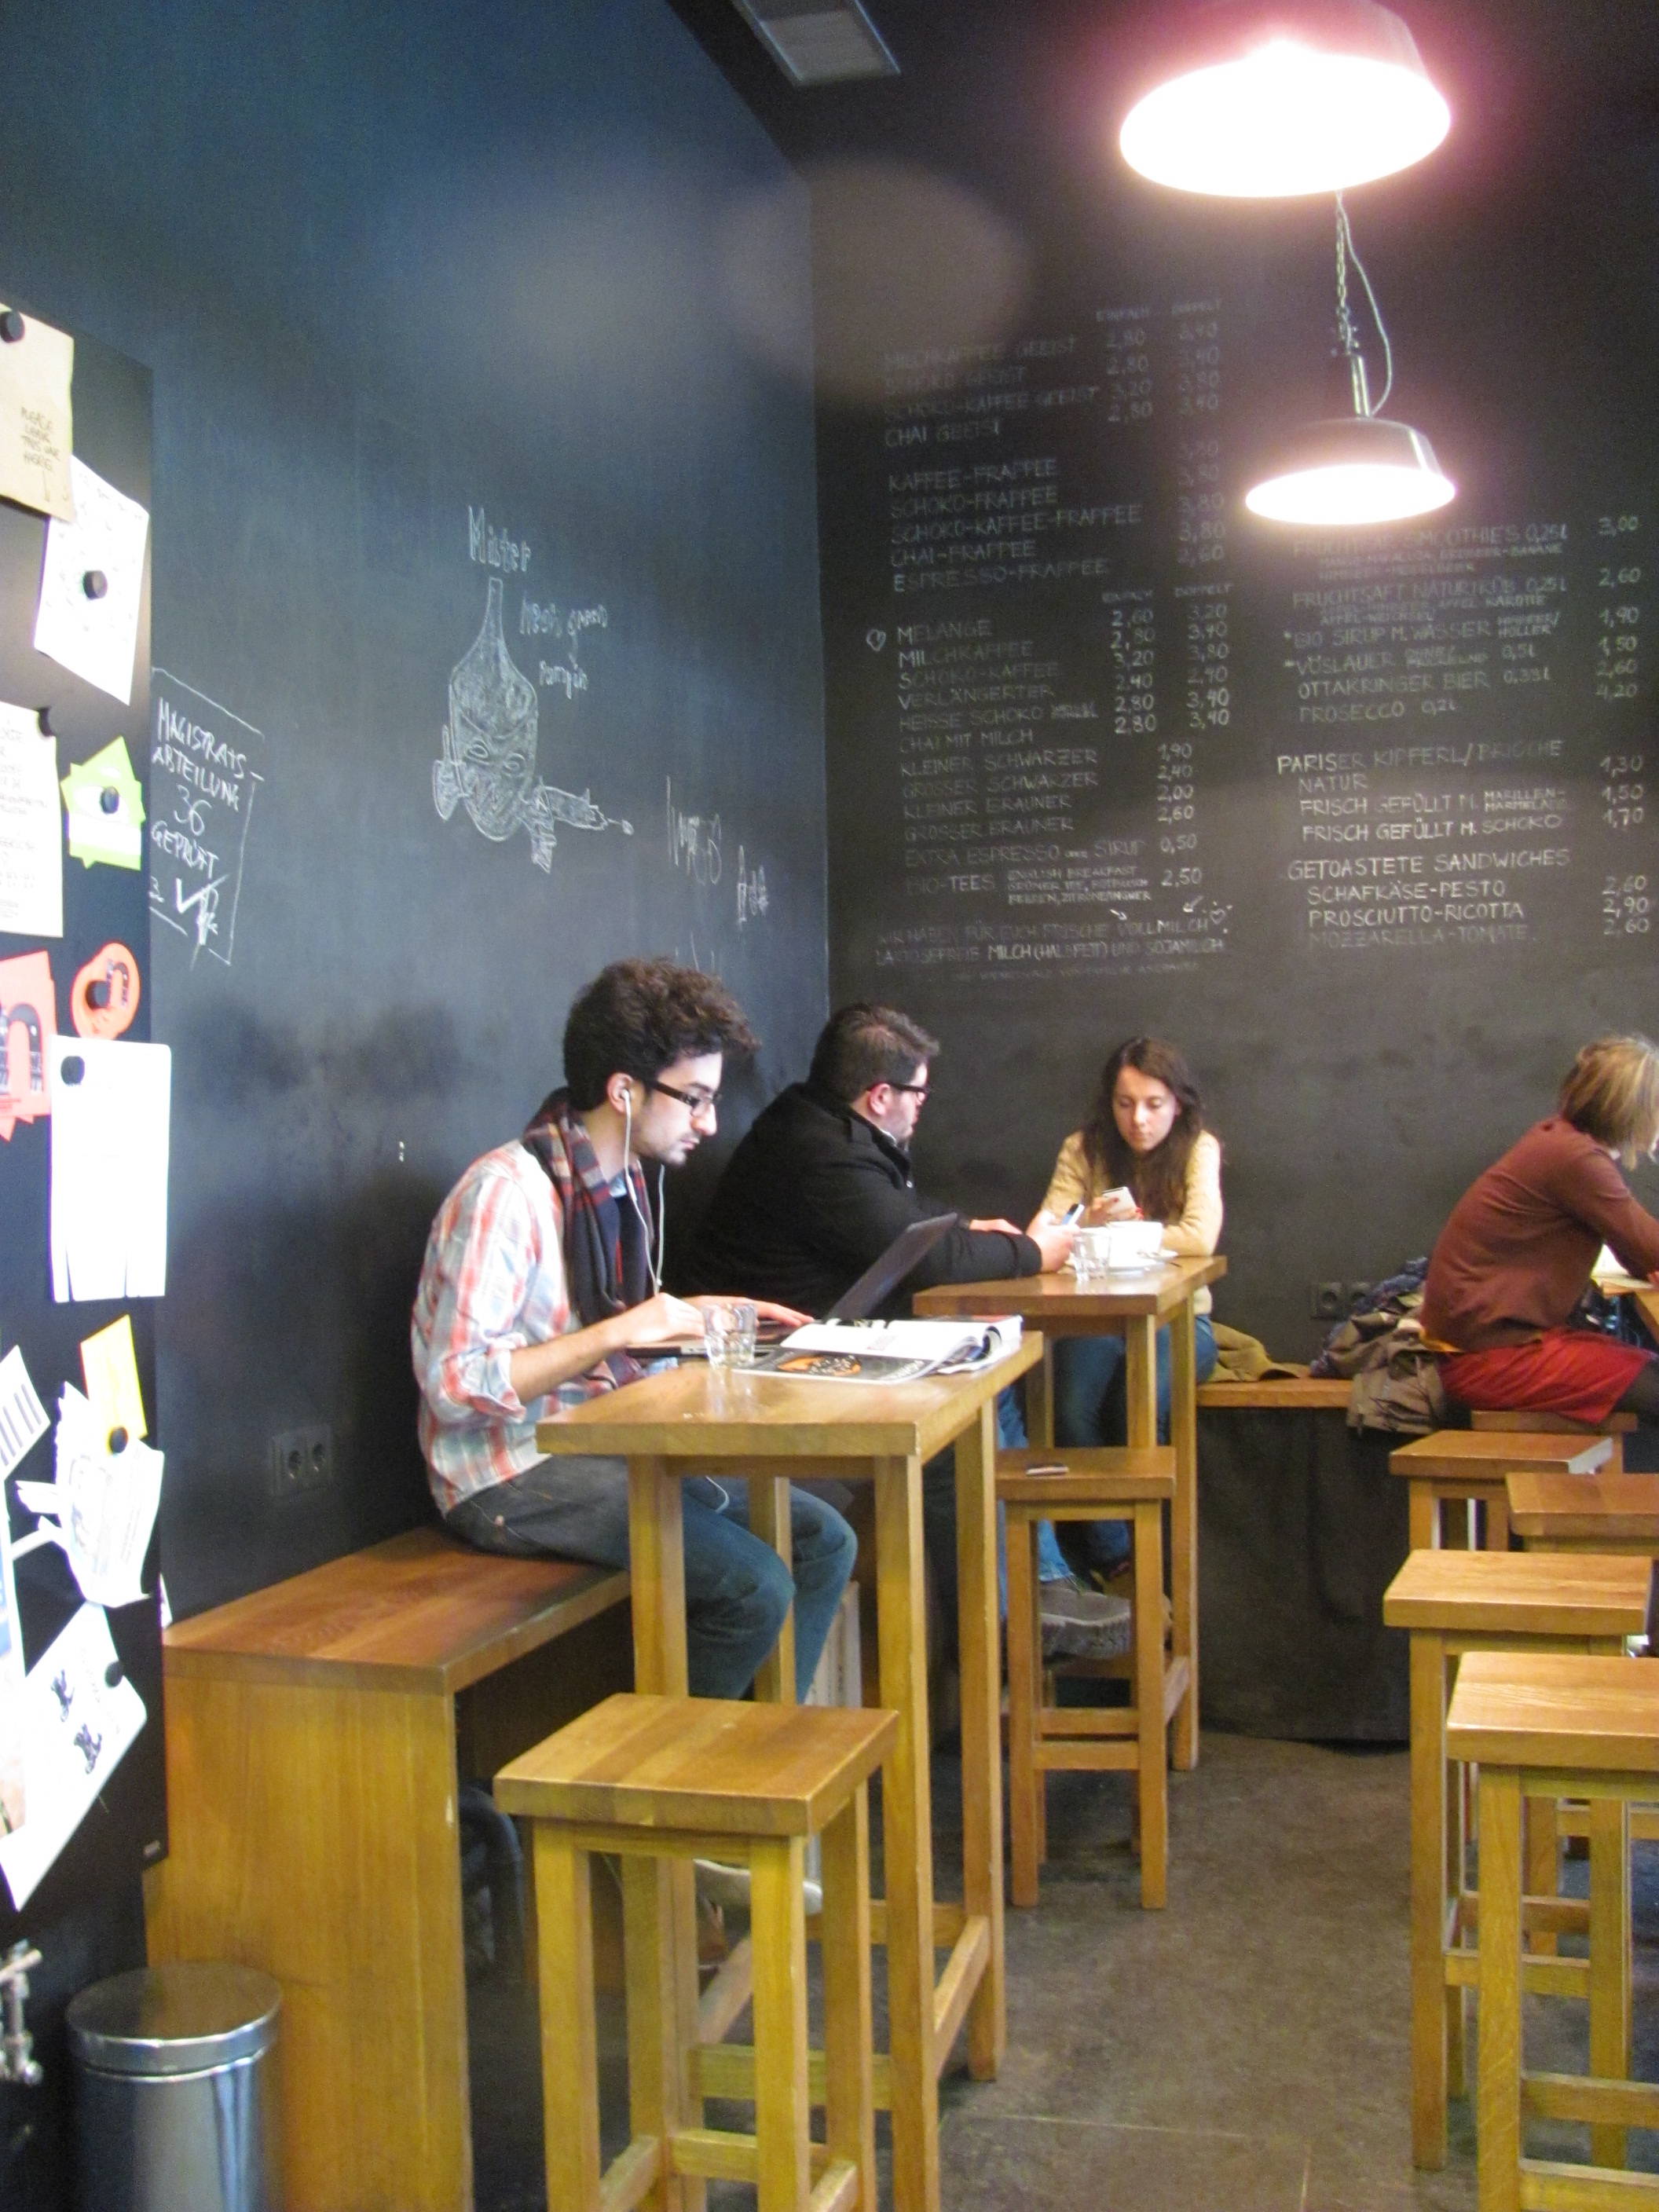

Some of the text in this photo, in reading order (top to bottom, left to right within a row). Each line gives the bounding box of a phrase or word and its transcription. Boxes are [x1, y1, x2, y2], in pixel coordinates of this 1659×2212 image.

[884, 425, 928, 447] CHAI
[1297, 672, 1434, 700] OTTAKRINGER
[1442, 669, 1491, 691] BIER
[945, 731, 972, 747] MIT
[980, 727, 1034, 748] MILCH
[983, 748, 1098, 772] SCHWARZER
[1276, 752, 1367, 775] PARISER
[1298, 772, 1370, 795] NATUR
[173, 783, 213, 837] 36
[1299, 797, 1368, 817] FRISCH
[1302, 824, 1369, 842] FRISCH
[1375, 816, 1455, 840] GEFÜLLT
[1287, 847, 1571, 881] GETOASTETE SANDWICHES
[1306, 878, 1507, 906] SCHAFKÄSE-PESTO
[1307, 901, 1525, 928] PROSCIUTTO-RICOTTA
